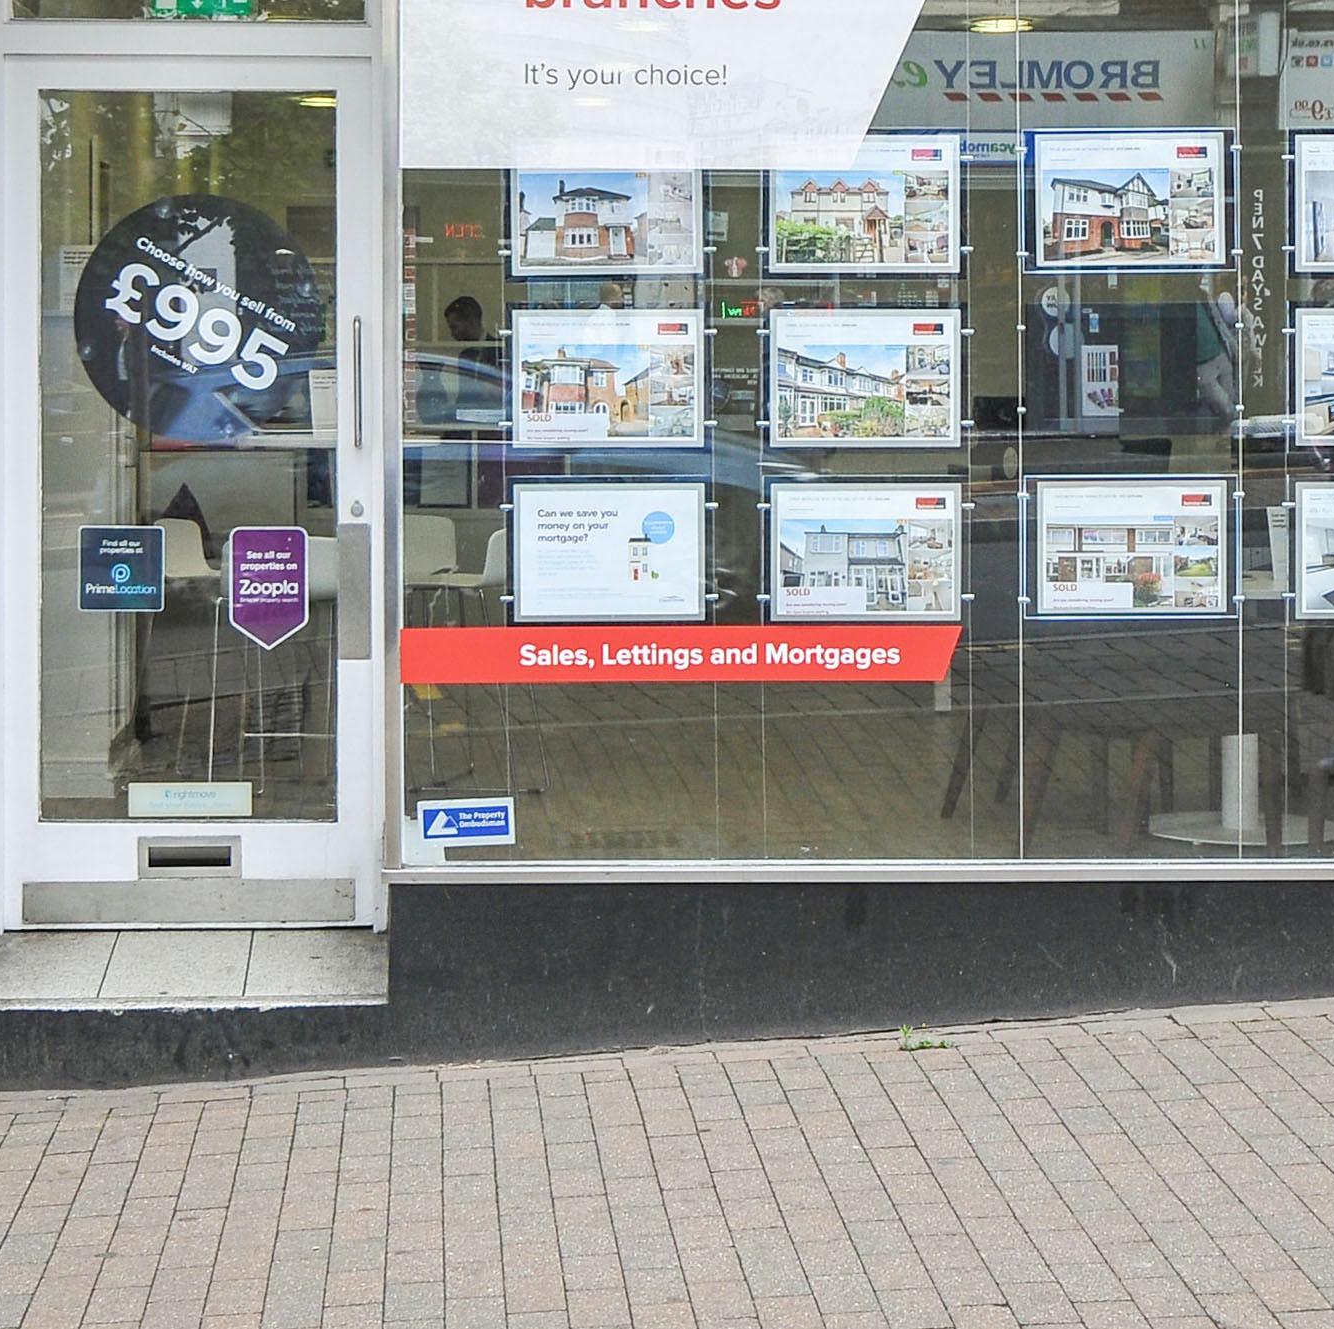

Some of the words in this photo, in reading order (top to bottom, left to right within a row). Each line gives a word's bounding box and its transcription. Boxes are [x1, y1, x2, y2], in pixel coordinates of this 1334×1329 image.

[524, 63, 558, 85] It's
[568, 67, 623, 91] your
[634, 63, 727, 87] choice!
[137, 236, 186, 272] Choose
[186, 263, 214, 286] how
[215, 280, 241, 302] you
[241, 295, 265, 316] sell
[265, 307, 296, 332] from
[106, 263, 289, 390] £995
[151, 345, 181, 367] Includes
[181, 360, 199, 374] VAT
[526, 414, 552, 423] SOLD
[537, 509, 557, 517] Can
[560, 510, 573, 518] we
[576, 510, 598, 518] save
[601, 510, 618, 520] you
[537, 523, 569, 532] money
[588, 522, 609, 532] your
[537, 533, 589, 544] mortgage?
[246, 551, 263, 560] See
[264, 550, 275, 559] all
[276, 552, 291, 560] our
[240, 561, 284, 572] properties
[286, 563, 298, 571] on
[85, 583, 156, 596] PrimeLocation
[239, 579, 299, 598] Zoopla
[786, 588, 811, 597] SOLD
[1052, 583, 1078, 592] SOLD
[519, 644, 595, 669] Sales,
[602, 644, 703, 669] Lettings
[710, 644, 757, 665] and
[765, 644, 900, 670] Mortgages
[459, 811, 473, 820] The
[474, 810, 505, 821] Property
[459, 819, 506, 829] Ombudsman
